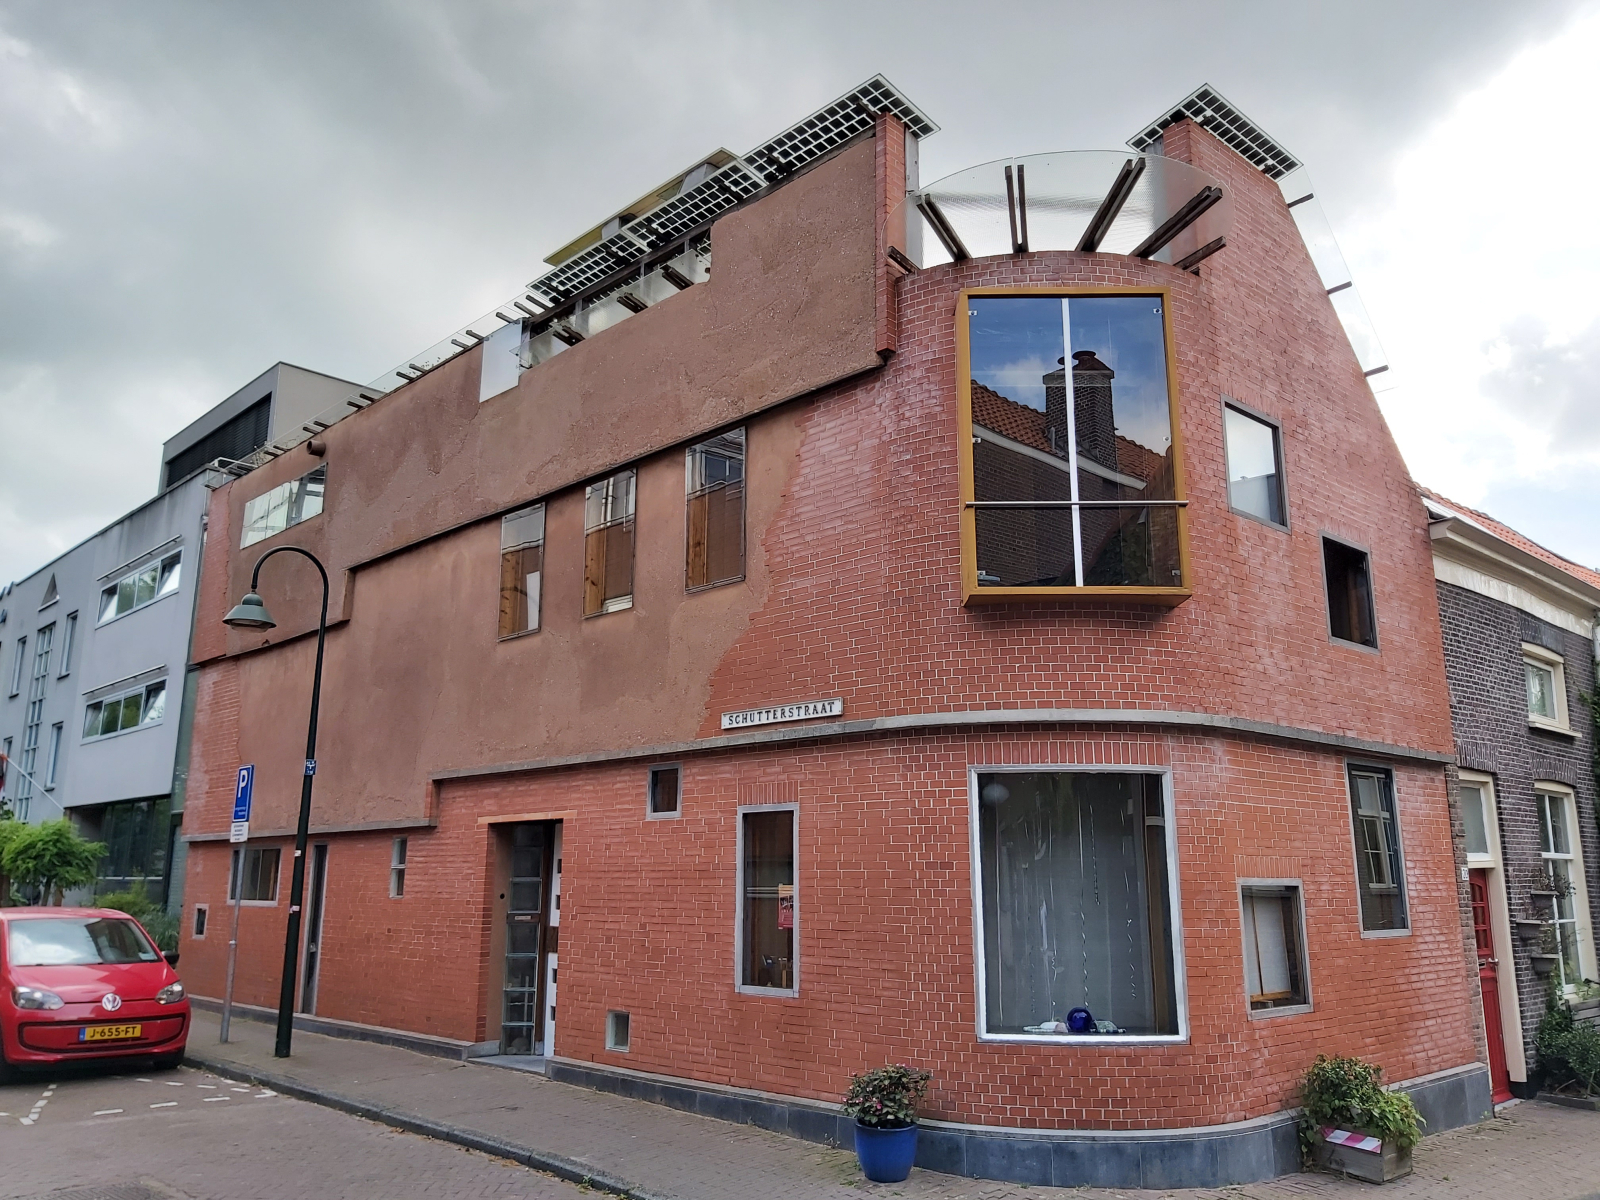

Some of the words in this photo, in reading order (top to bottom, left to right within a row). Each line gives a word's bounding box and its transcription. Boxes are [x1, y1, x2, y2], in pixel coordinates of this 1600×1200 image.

[728, 701, 835, 725] SCHUTTERSTRAAT
[238, 769, 248, 798] P
[89, 1026, 138, 1038] J-655-FT
